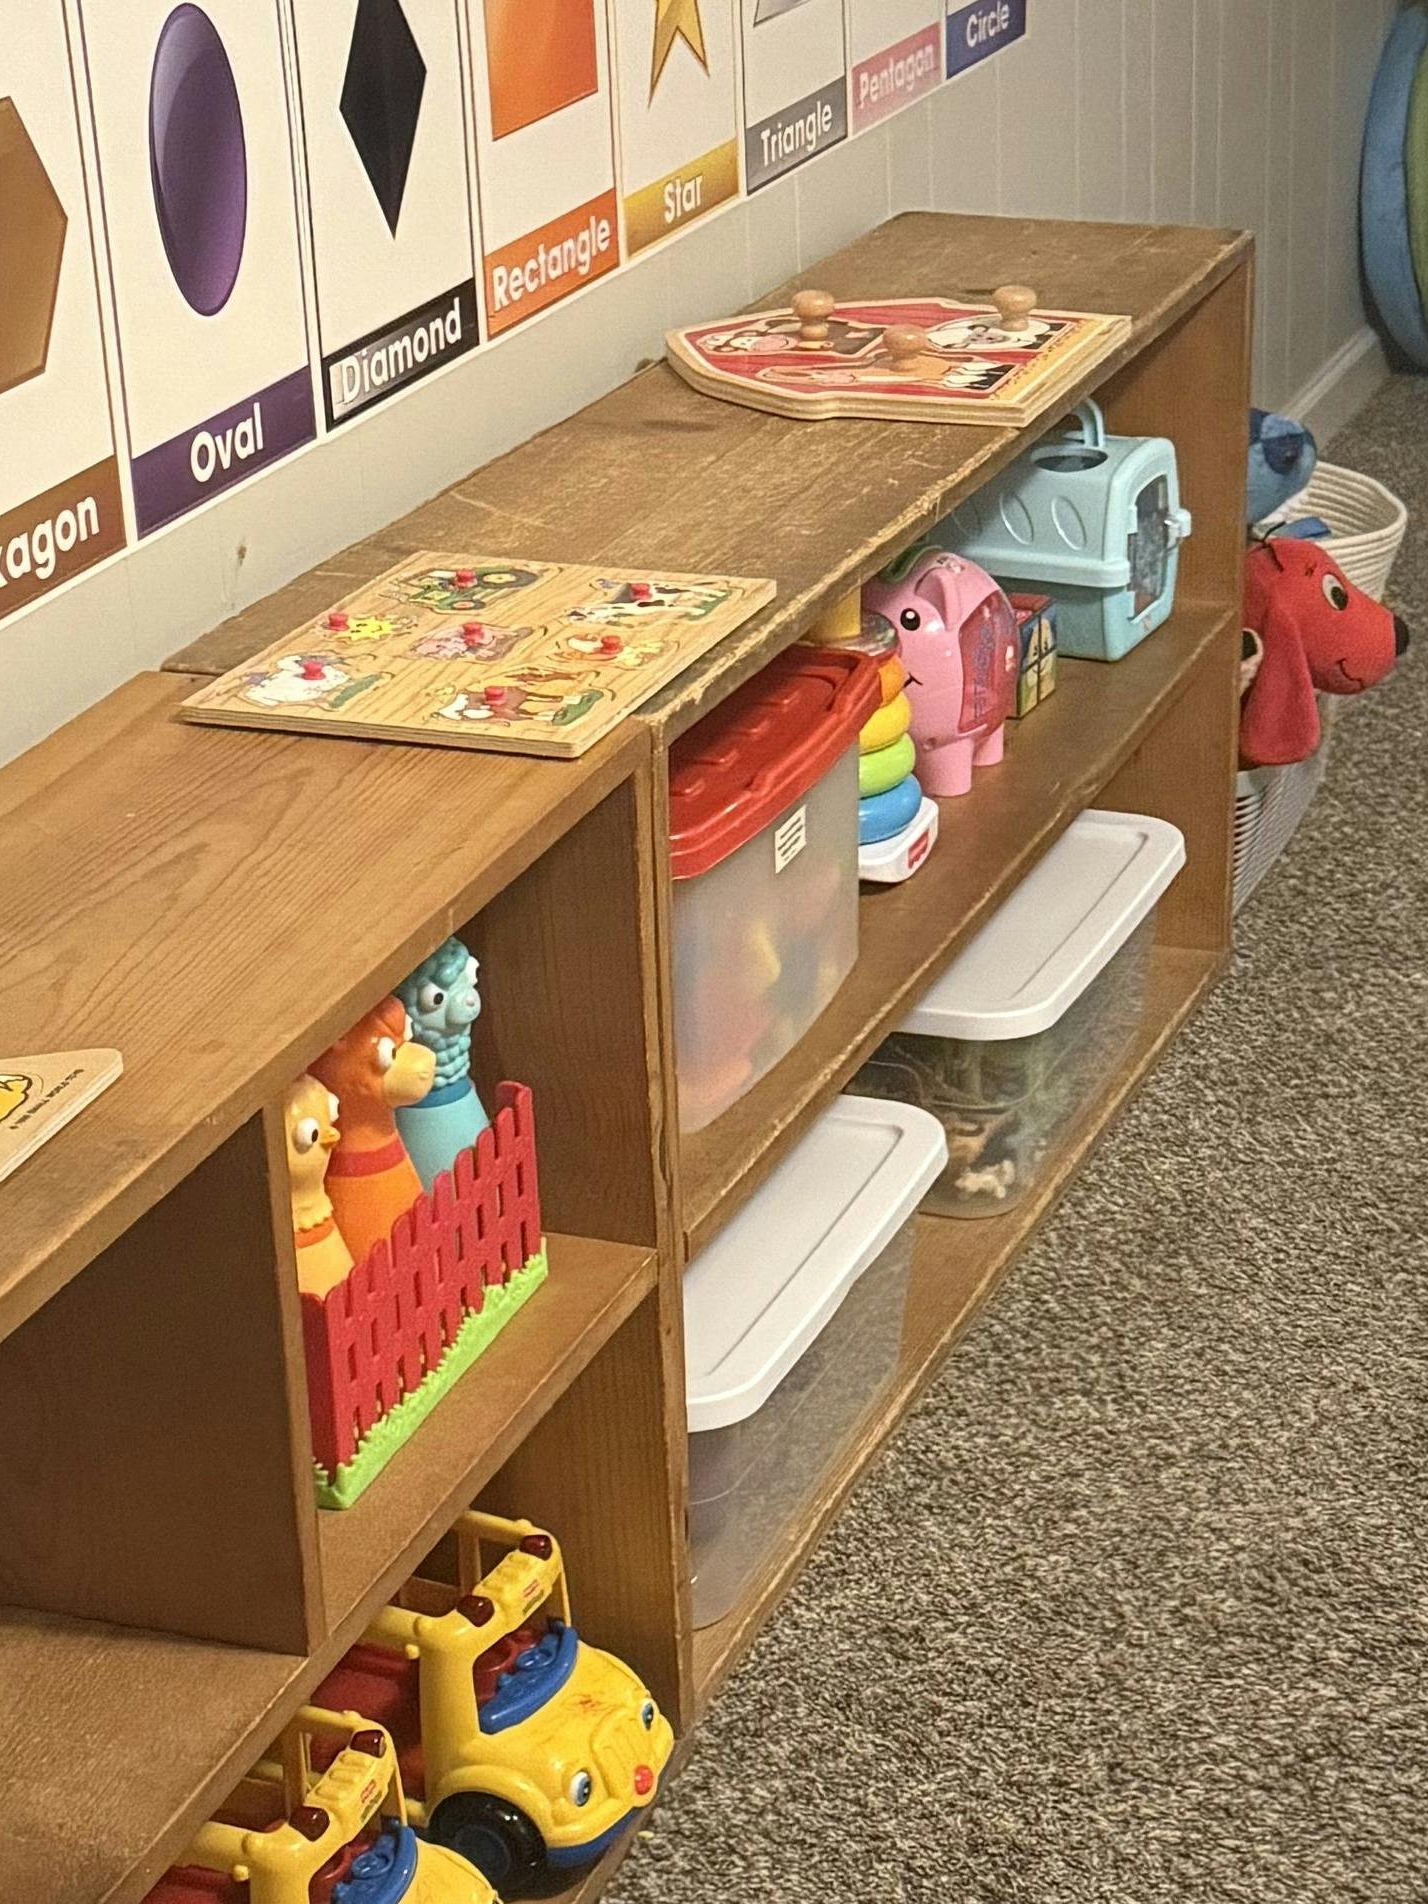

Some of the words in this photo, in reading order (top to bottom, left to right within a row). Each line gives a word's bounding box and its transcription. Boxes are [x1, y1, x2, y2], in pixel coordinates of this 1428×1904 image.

[965, 0, 1010, 48] Circle
[858, 42, 935, 109] Pentagon
[760, 101, 833, 168] Triangle
[663, 172, 704, 224] Star
[492, 215, 611, 312] Rectangle
[339, 298, 462, 405] Diamond
[189, 402, 264, 484] Oval
